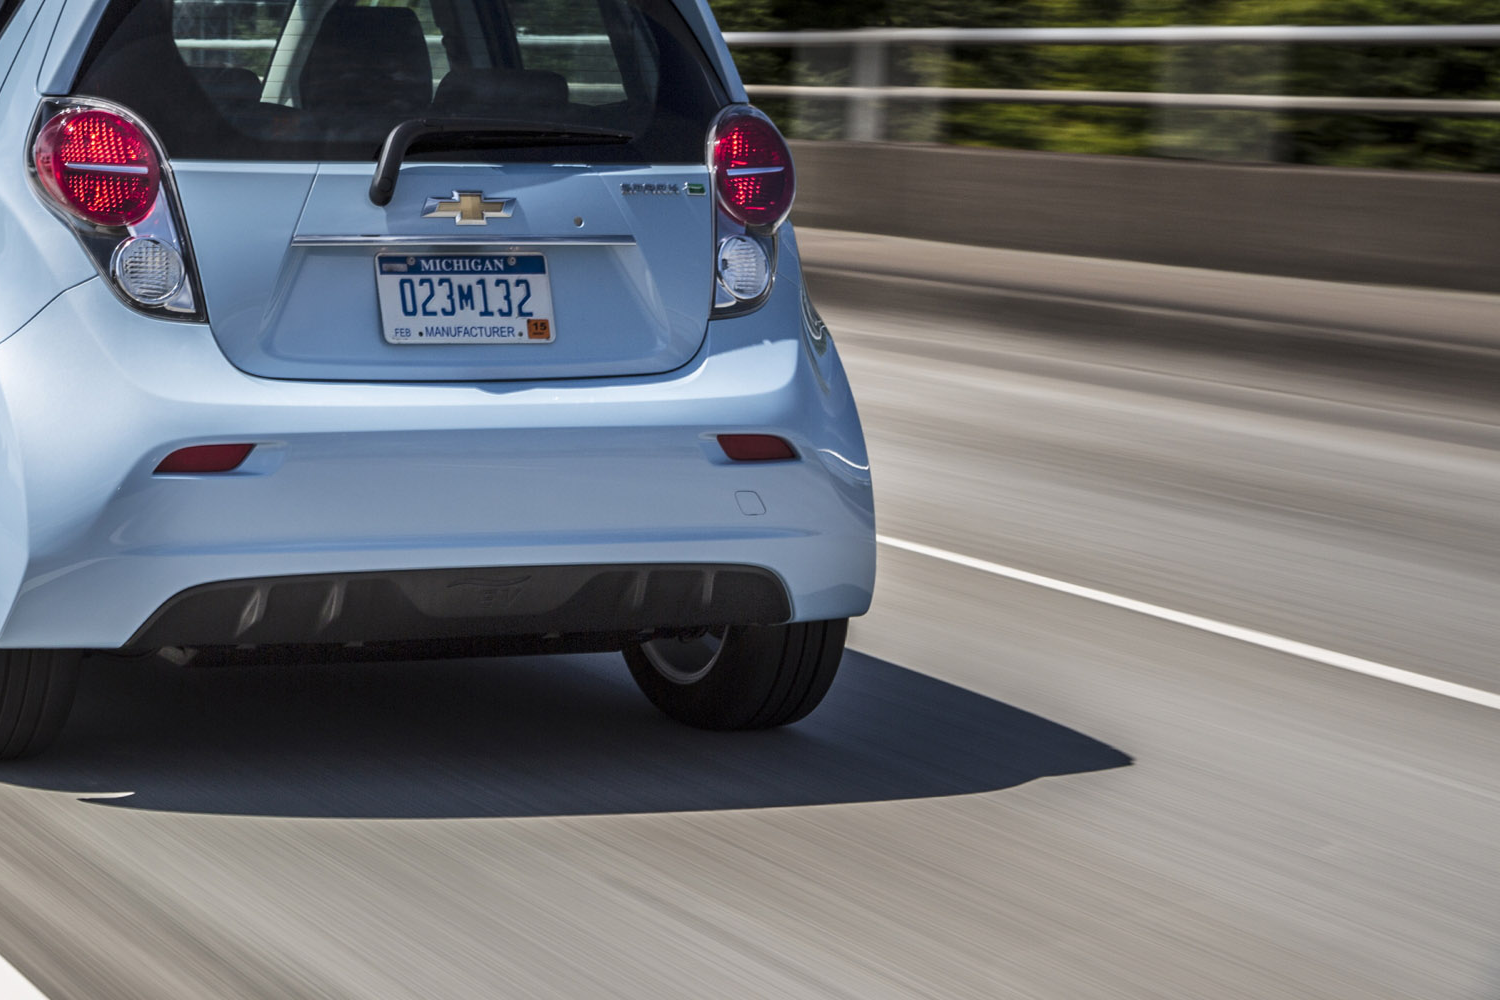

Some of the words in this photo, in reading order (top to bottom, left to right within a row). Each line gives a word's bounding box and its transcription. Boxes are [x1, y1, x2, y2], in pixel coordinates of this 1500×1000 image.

[620, 183, 680, 196] SPARK
[420, 258, 504, 272] MICHIGAN
[399, 278, 534, 317] 023M132
[394, 328, 412, 337] FEB
[425, 327, 515, 338] MANUFACTURER
[533, 322, 547, 331] 15
